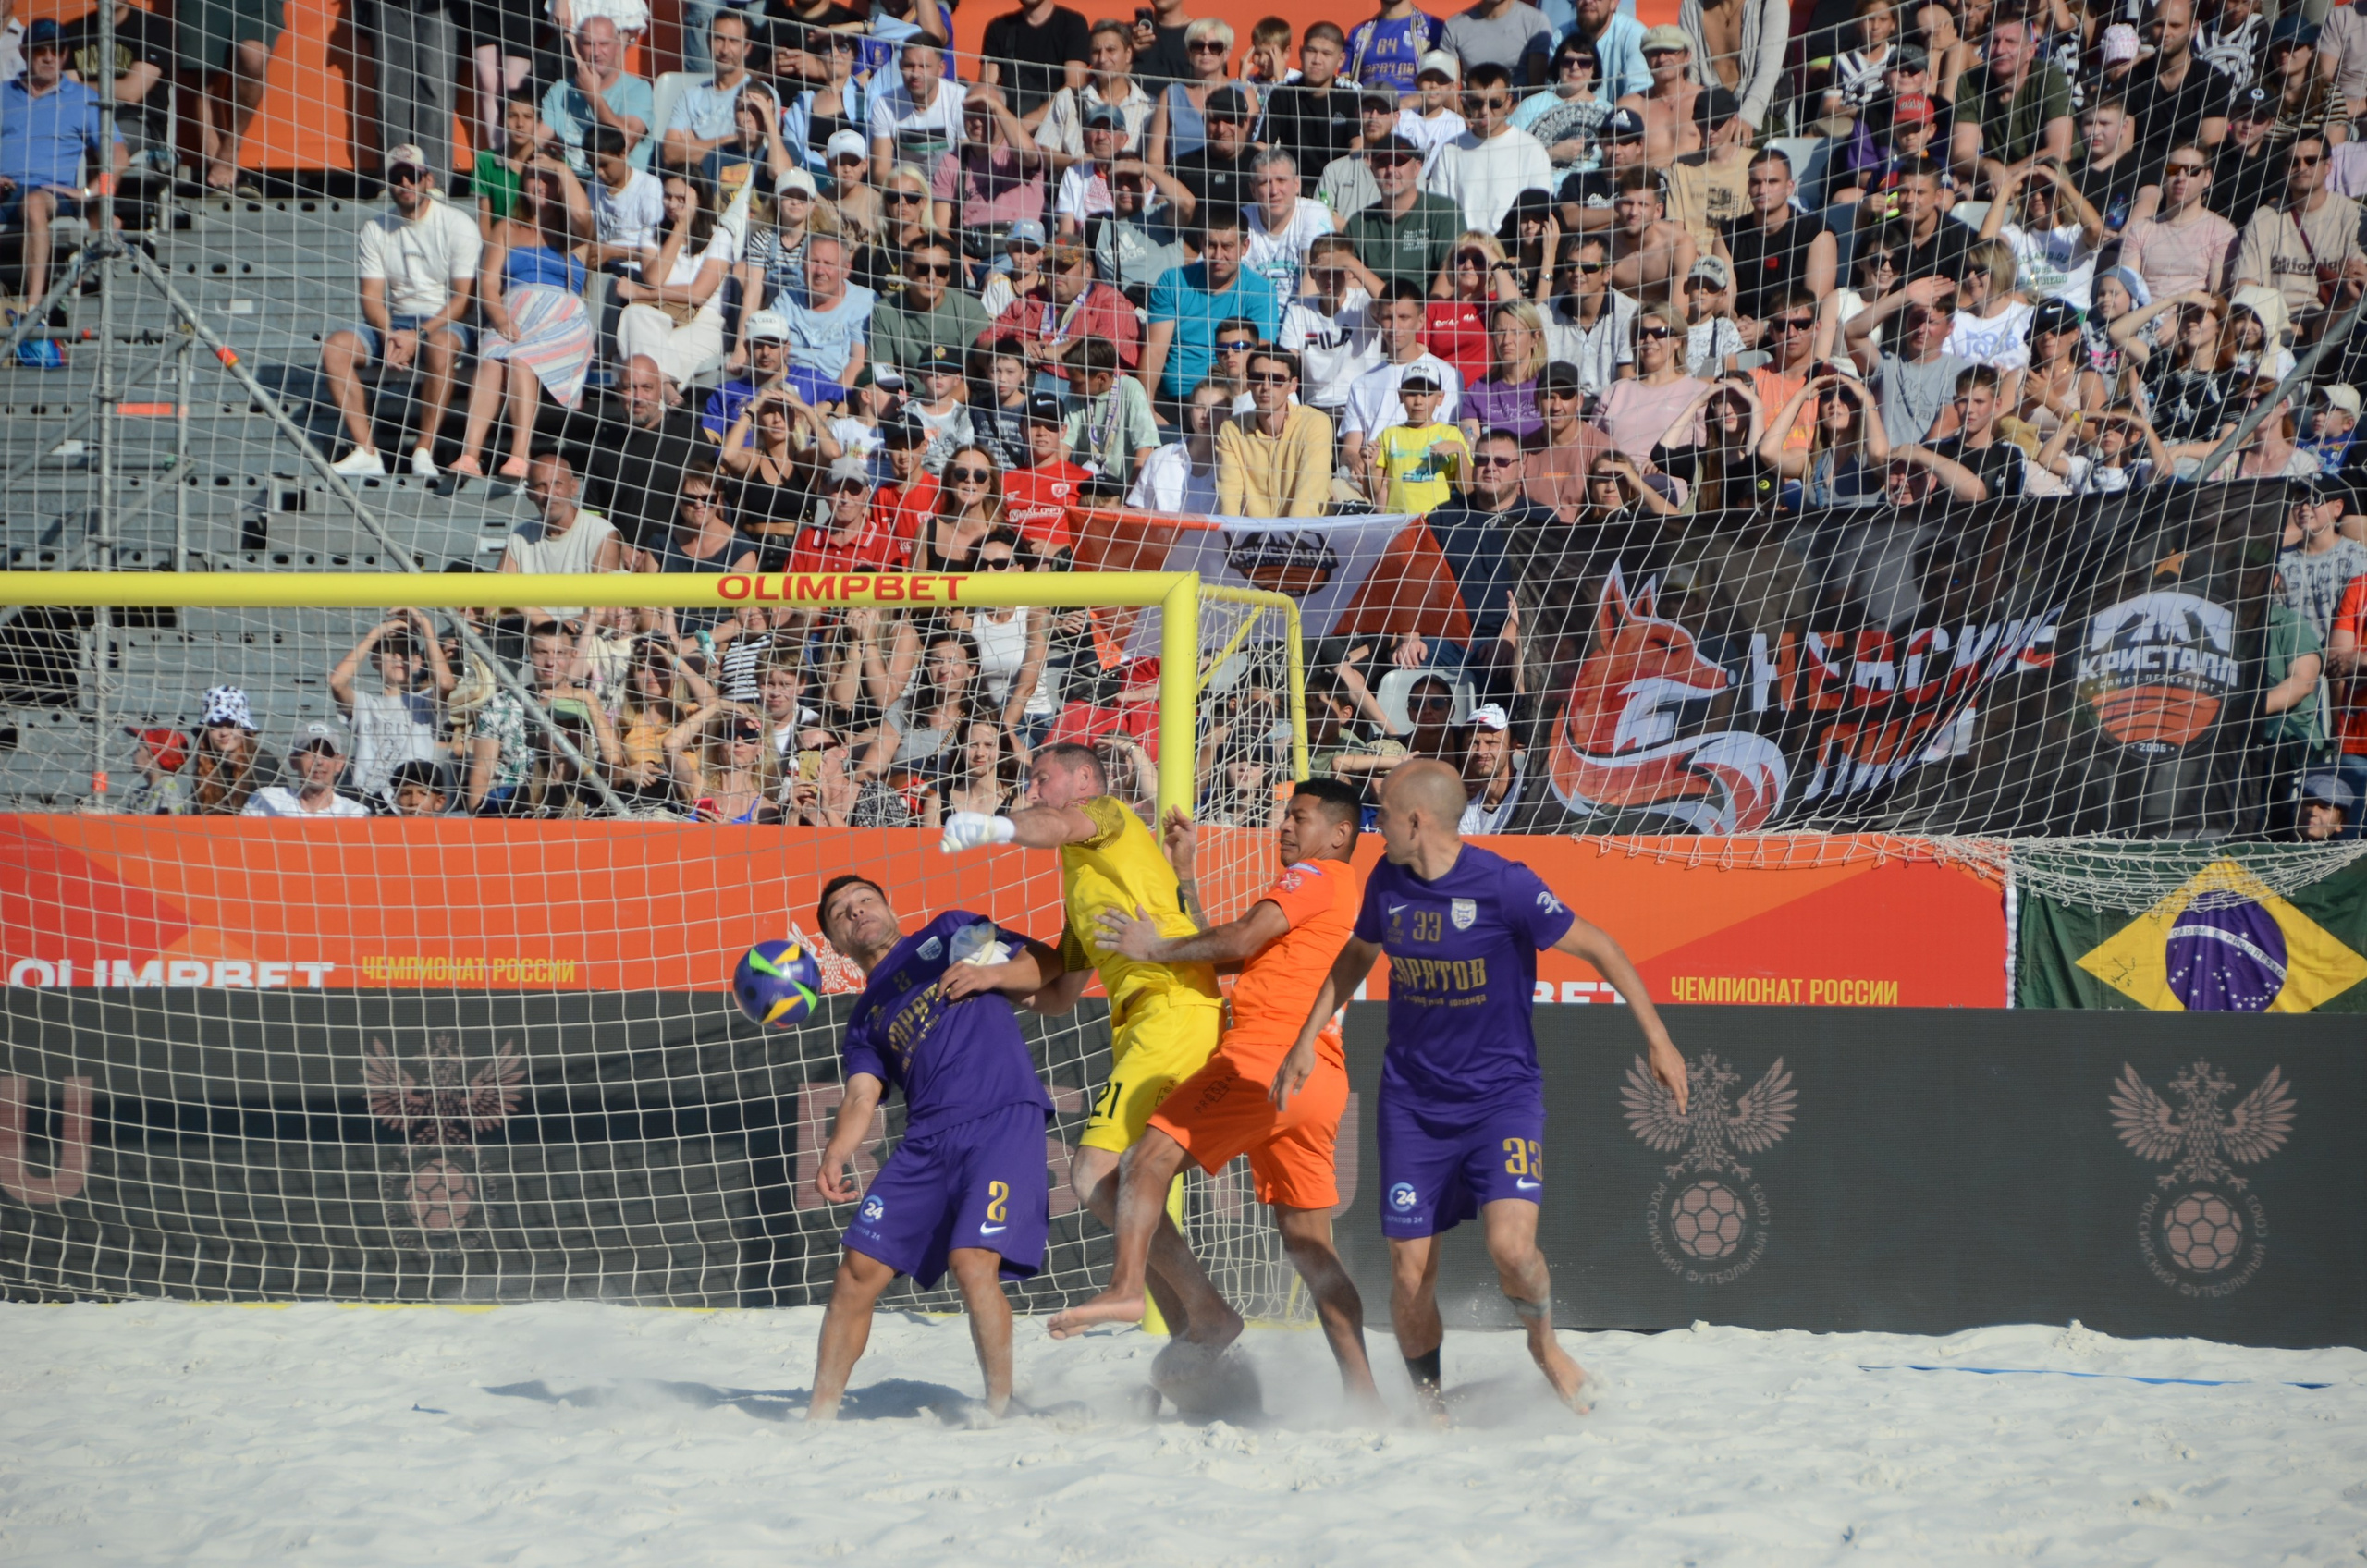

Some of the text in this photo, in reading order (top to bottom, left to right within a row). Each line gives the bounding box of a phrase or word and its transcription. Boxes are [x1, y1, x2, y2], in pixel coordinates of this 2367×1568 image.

[1376, 38, 1398, 55] 84
[1100, 245, 1147, 265] addas
[717, 575, 968, 601] OLIMPBET
[2077, 644, 2238, 687] КРИСТАЛЛ
[2100, 673, 2216, 692] САНКТ-ПЕТЕРБУРГ
[2139, 742, 2166, 753] 2006
[2172, 926, 2205, 937] ORDEM
[2226, 934, 2285, 977] PROGRESSO
[362, 956, 575, 982] ЧЕМПИОНАТ РОССИИ
[1671, 976, 1898, 1006] ЧЕМПИОНАТ РОССИИ
[1091, 1081, 1122, 1119] 21
[1502, 1137, 1543, 1181] 33
[987, 1180, 1010, 1223] 2
